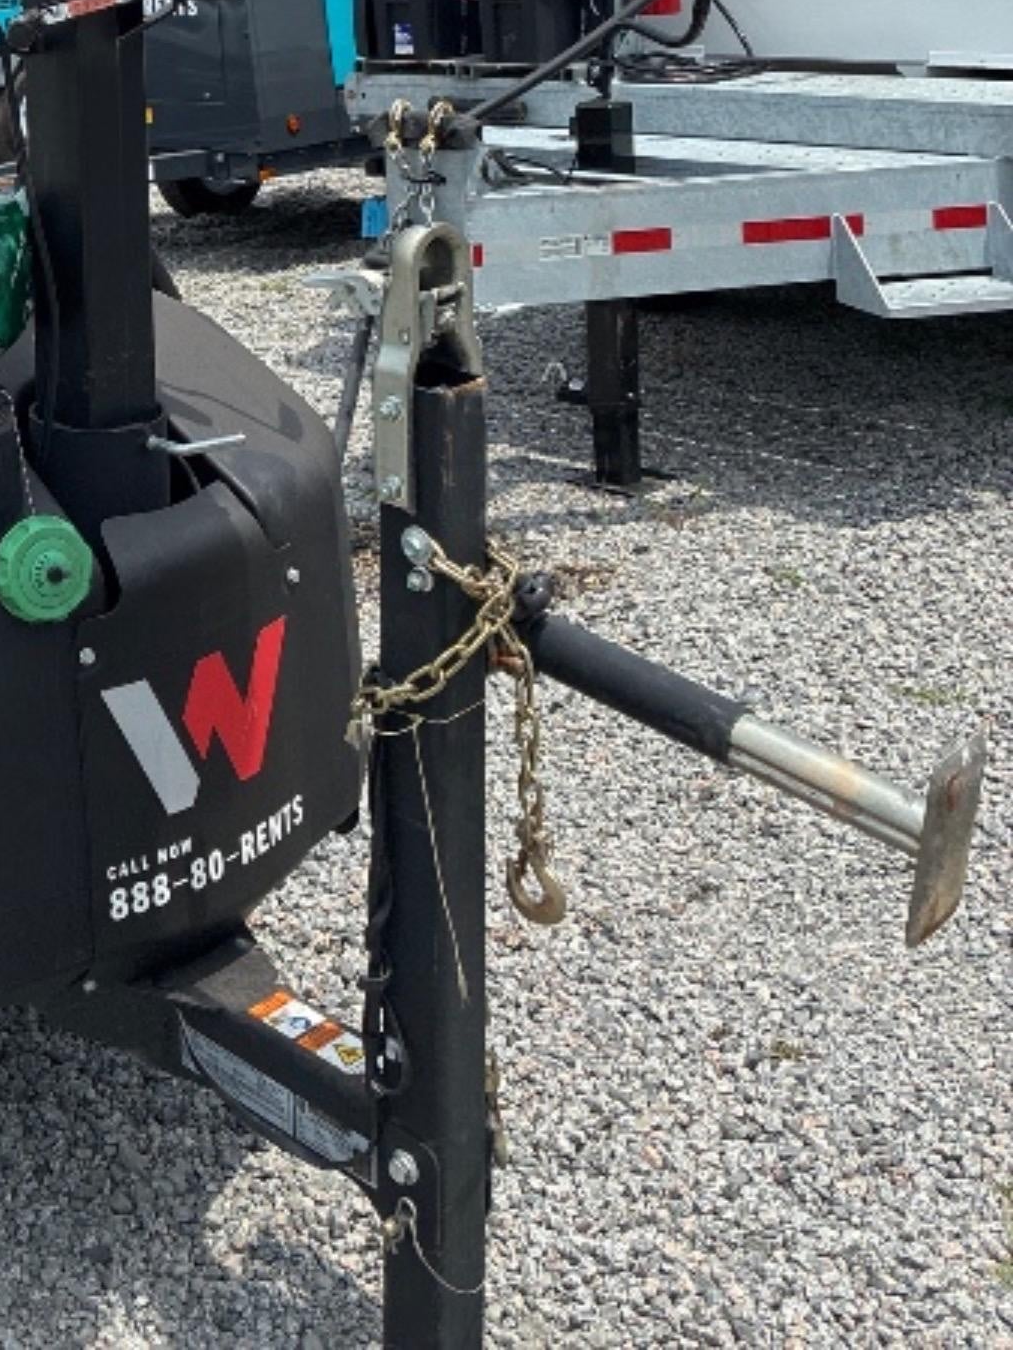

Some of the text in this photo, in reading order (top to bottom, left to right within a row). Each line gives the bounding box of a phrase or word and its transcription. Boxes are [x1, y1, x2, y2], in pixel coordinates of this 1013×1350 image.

[106, 836, 193, 881] CALL NOW
[109, 794, 304, 922] 888-80-RENTS
